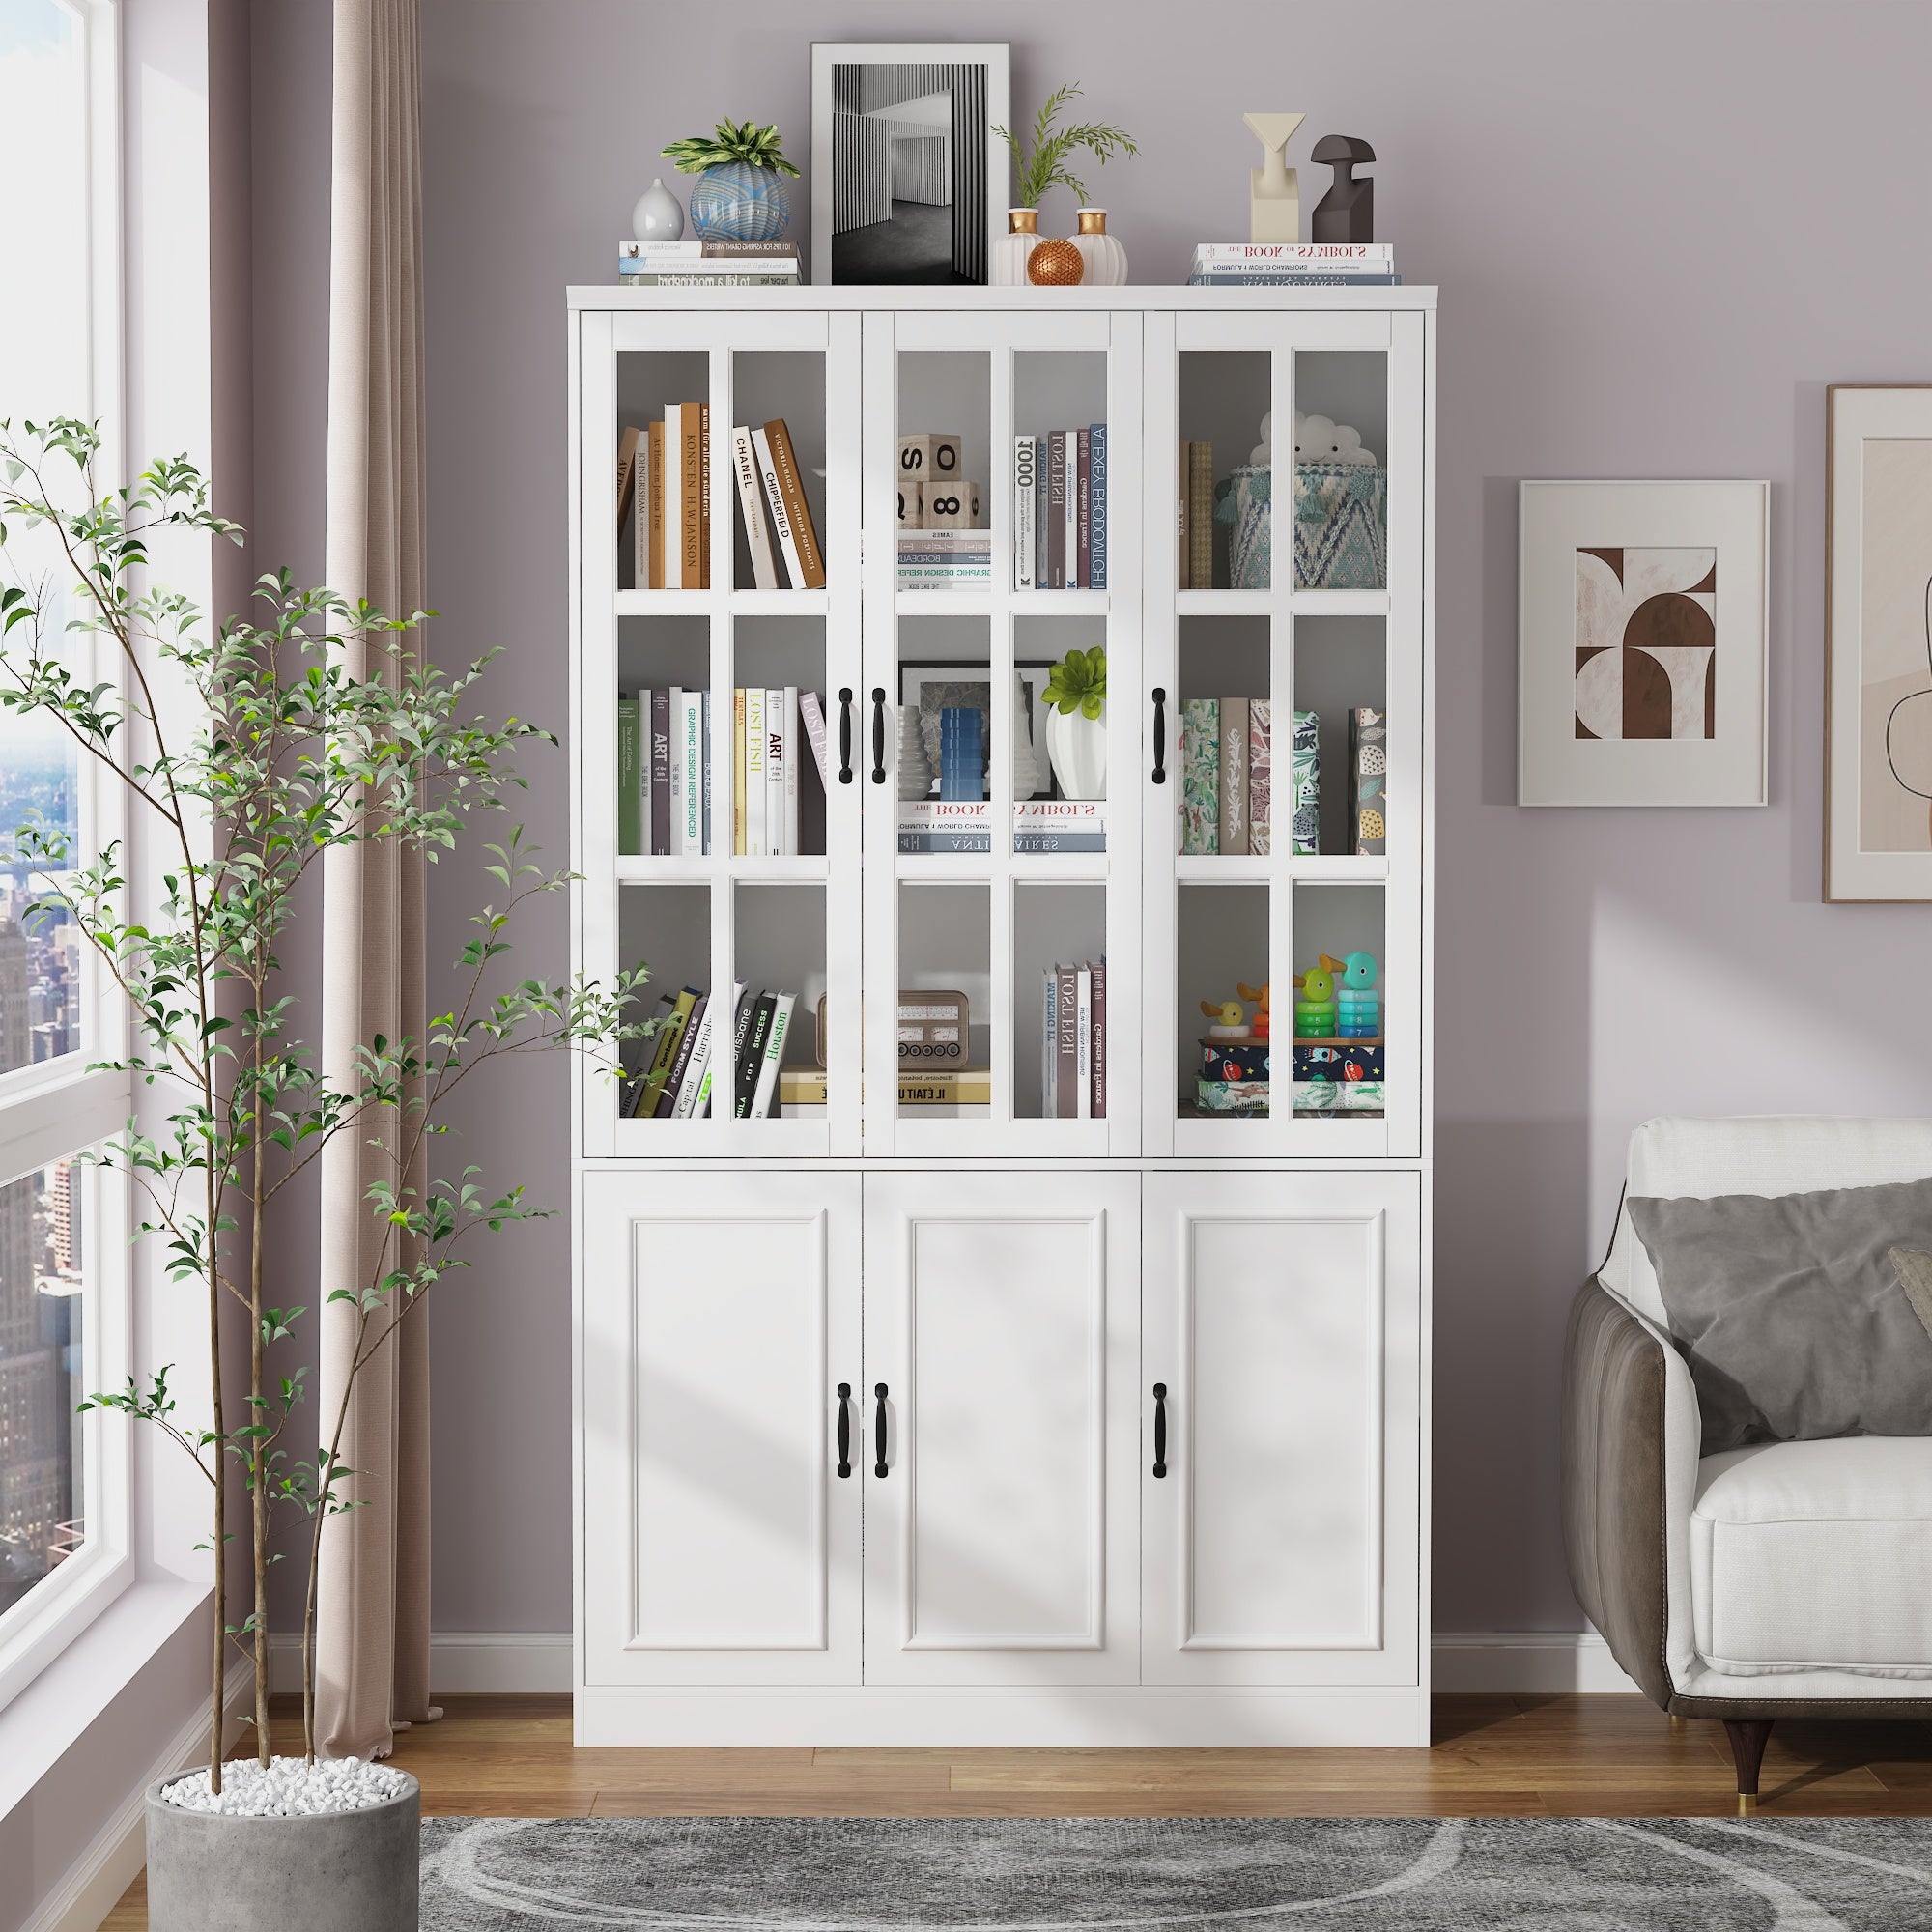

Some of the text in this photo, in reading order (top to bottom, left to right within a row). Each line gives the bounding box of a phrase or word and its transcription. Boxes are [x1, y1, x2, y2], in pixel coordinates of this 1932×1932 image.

[687, 435, 696, 488] KONSTEN
[737, 438, 752, 489] CHANEL
[774, 433, 795, 493] VICTORIA HAGAN
[653, 484, 661, 511] Joshua
[766, 473, 789, 538] CHIPPERFIELD
[793, 502, 815, 570] INTERIOR PORTRAITS
[749, 694, 762, 772] LOST FISH
[802, 696, 824, 738] LOST
[654, 733, 667, 761] ART
[770, 733, 782, 761] ART
[671, 1016, 699, 1083] FORM STYLE
[745, 1062, 755, 1081] FOR
[753, 1010, 768, 1049] SUCCESS
[766, 1012, 788, 1060] Houston
